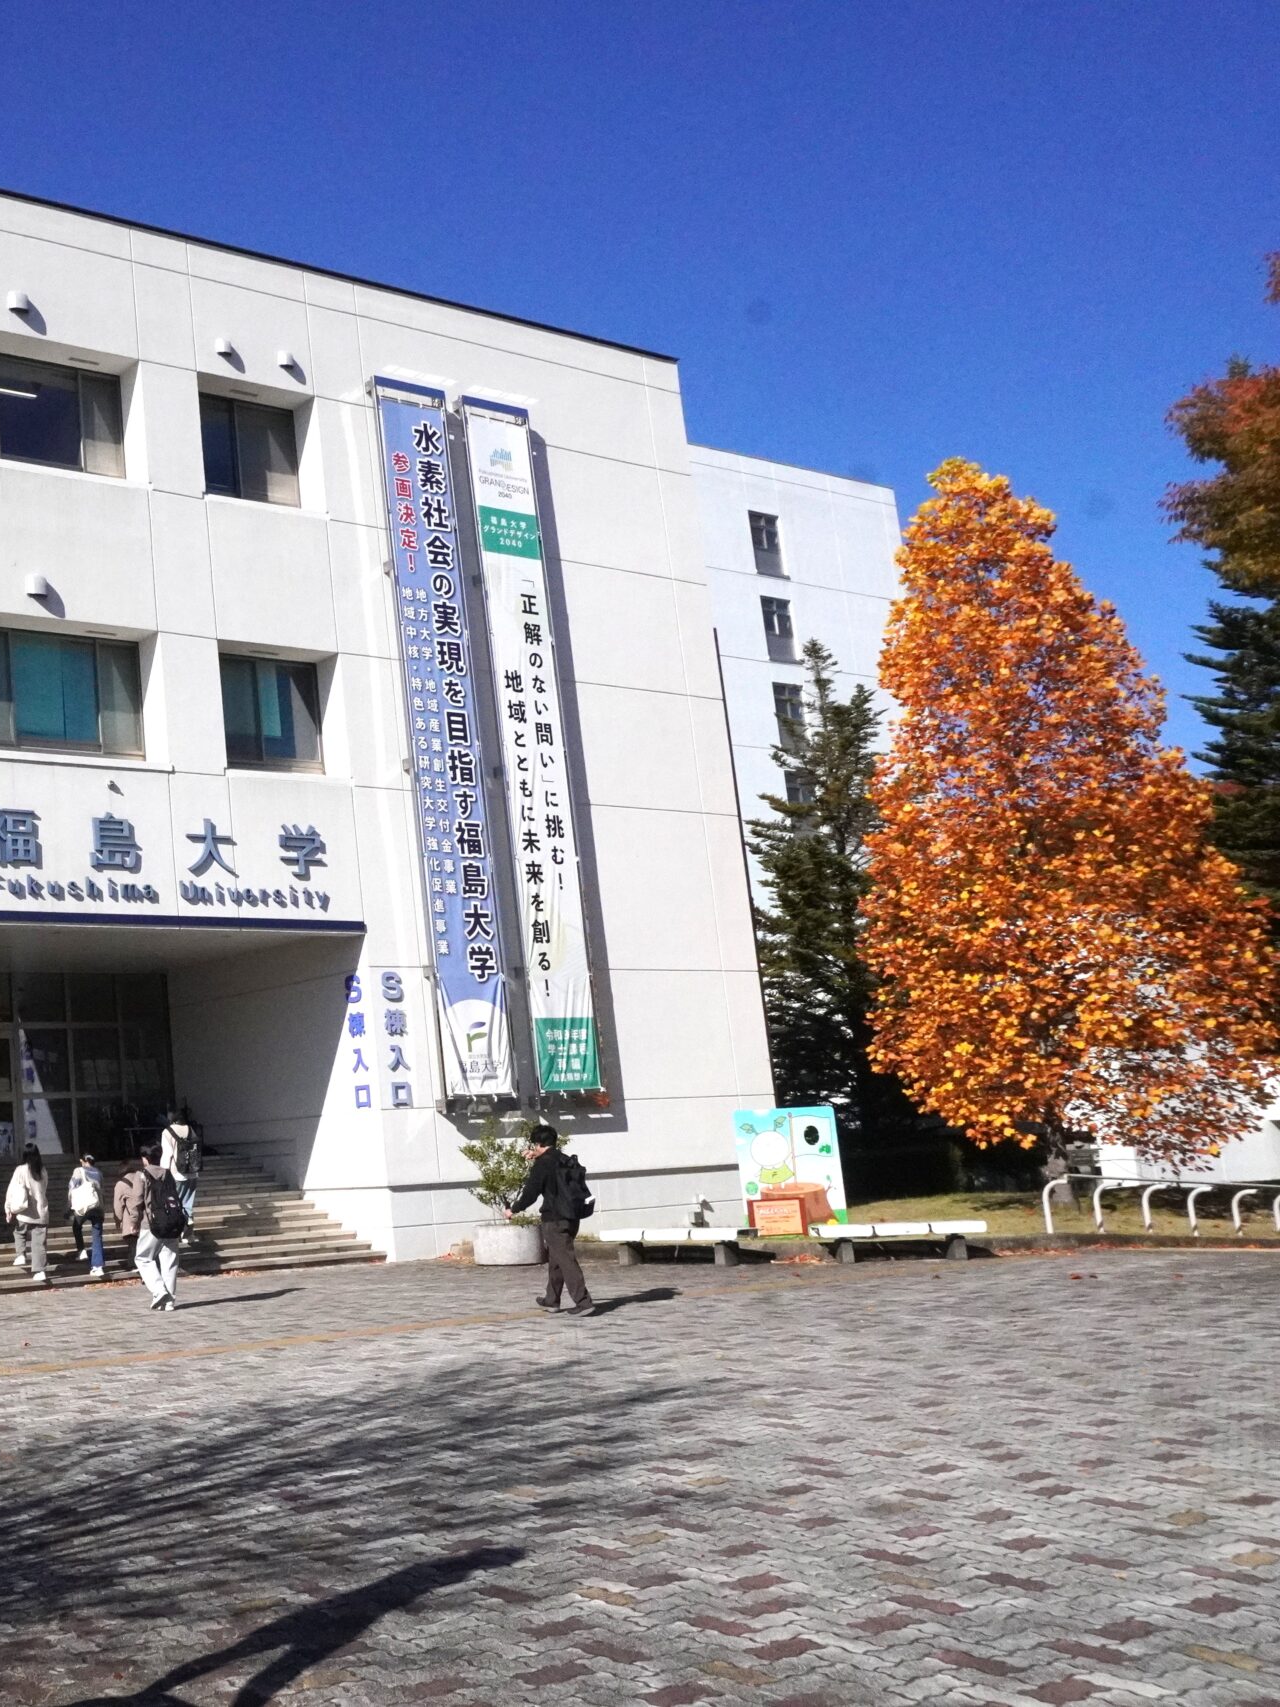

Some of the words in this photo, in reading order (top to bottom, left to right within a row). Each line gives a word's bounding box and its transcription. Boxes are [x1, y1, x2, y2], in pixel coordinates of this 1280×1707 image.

[483, 524, 536, 540] グランドデザイン
[499, 537, 523, 548] 2040
[413, 422, 498, 981] 水素社会の実現を目指す福島大学
[415, 587, 458, 895] 地方大学・地域産業創生交付金事業
[401, 586, 449, 955] 地域中核・特色ある研究大学強化促進事業
[179, 880, 331, 912] University
[345, 974, 372, 1109] S棟入口
[381, 971, 413, 1108] S棟入口
